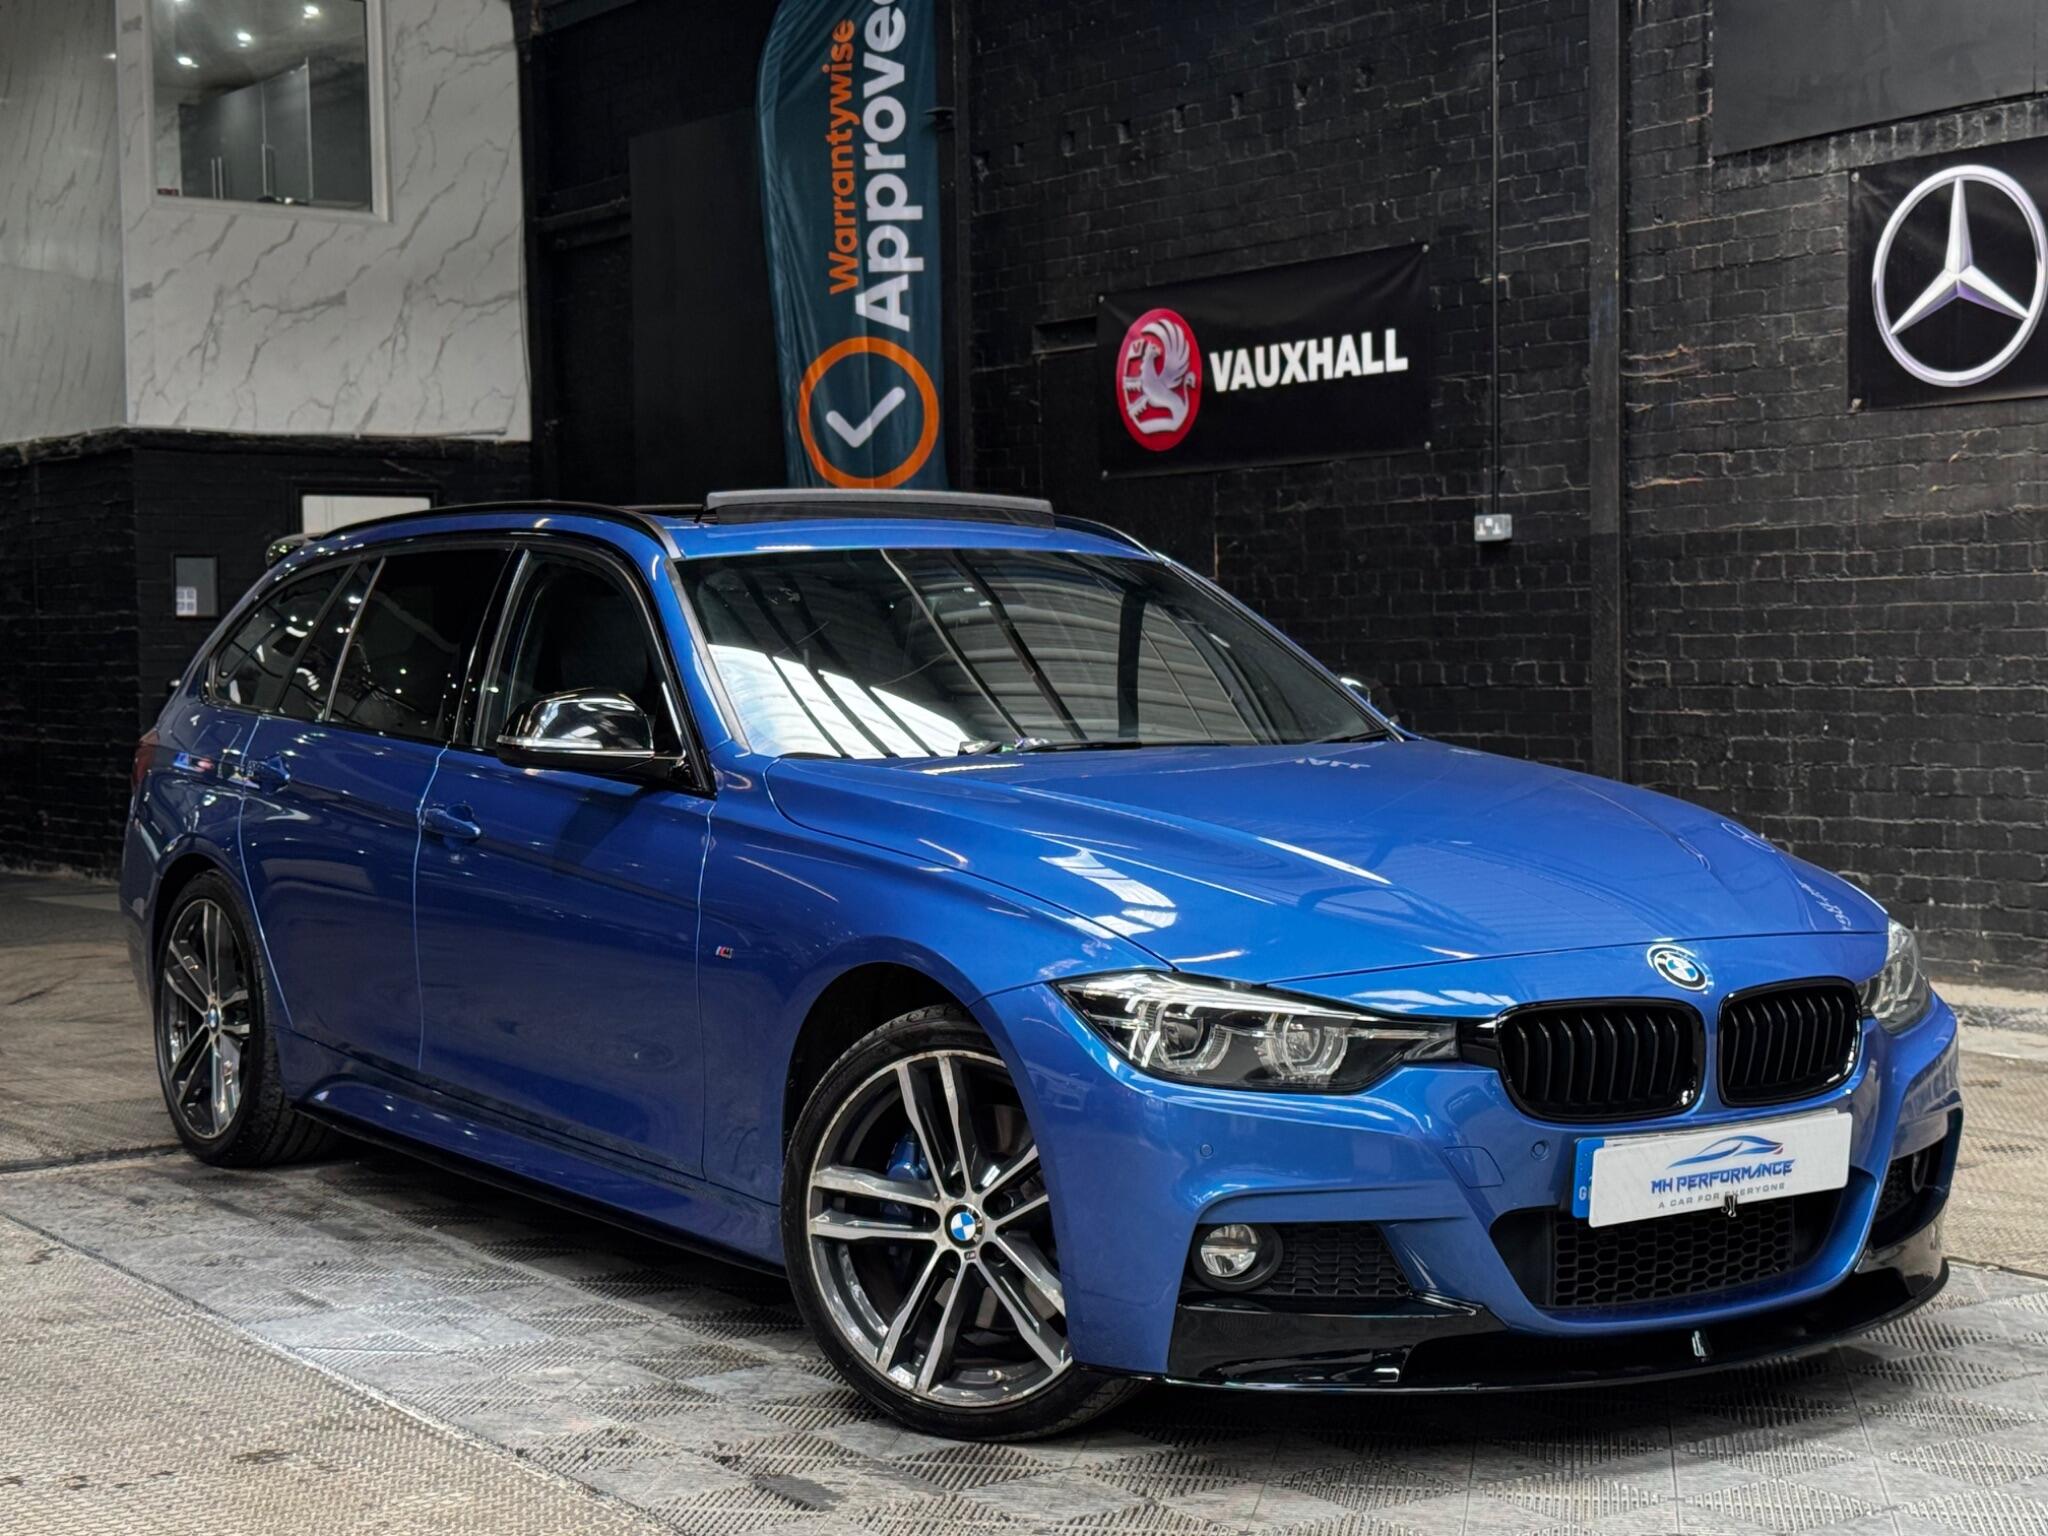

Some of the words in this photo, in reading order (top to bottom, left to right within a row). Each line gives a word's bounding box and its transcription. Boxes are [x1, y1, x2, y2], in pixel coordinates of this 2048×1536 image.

[822, 19, 860, 295] Warrantywise
[855, 0, 924, 332] Approve
[1210, 328, 1409, 393] VAUXHALL
[1650, 1177, 1674, 1195] MH
[1676, 1159, 1796, 1192] PERFORMANCE
[1657, 1200, 1666, 1210] A
[1669, 1197, 1693, 1208] CAR
[1697, 1192, 1721, 1202] FOR
